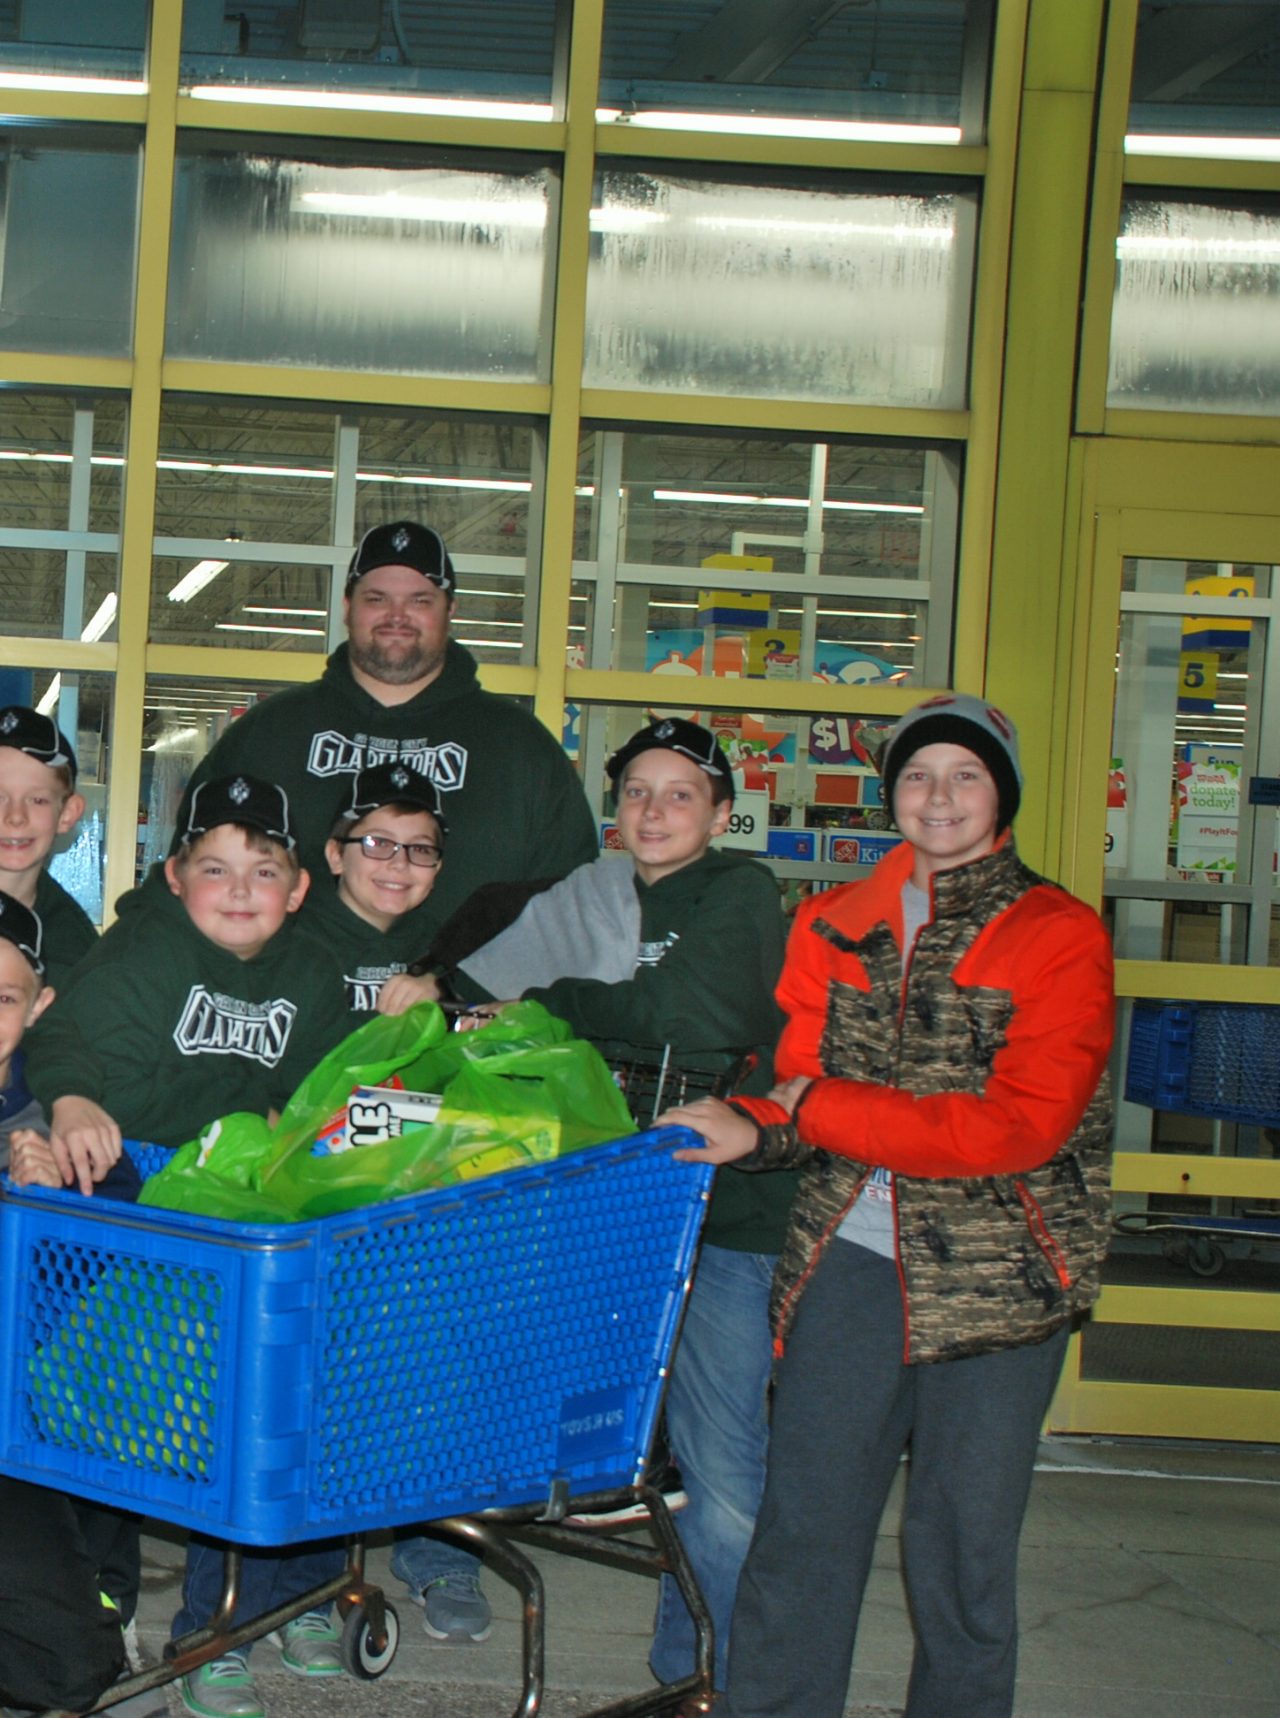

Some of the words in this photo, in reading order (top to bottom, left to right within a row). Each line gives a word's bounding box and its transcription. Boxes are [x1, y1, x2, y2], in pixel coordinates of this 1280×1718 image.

[1183, 662, 1205, 689] 5
[310, 733, 465, 787] GLADITORS
[1190, 783, 1237, 797] donate
[1192, 796, 1236, 811] today!
